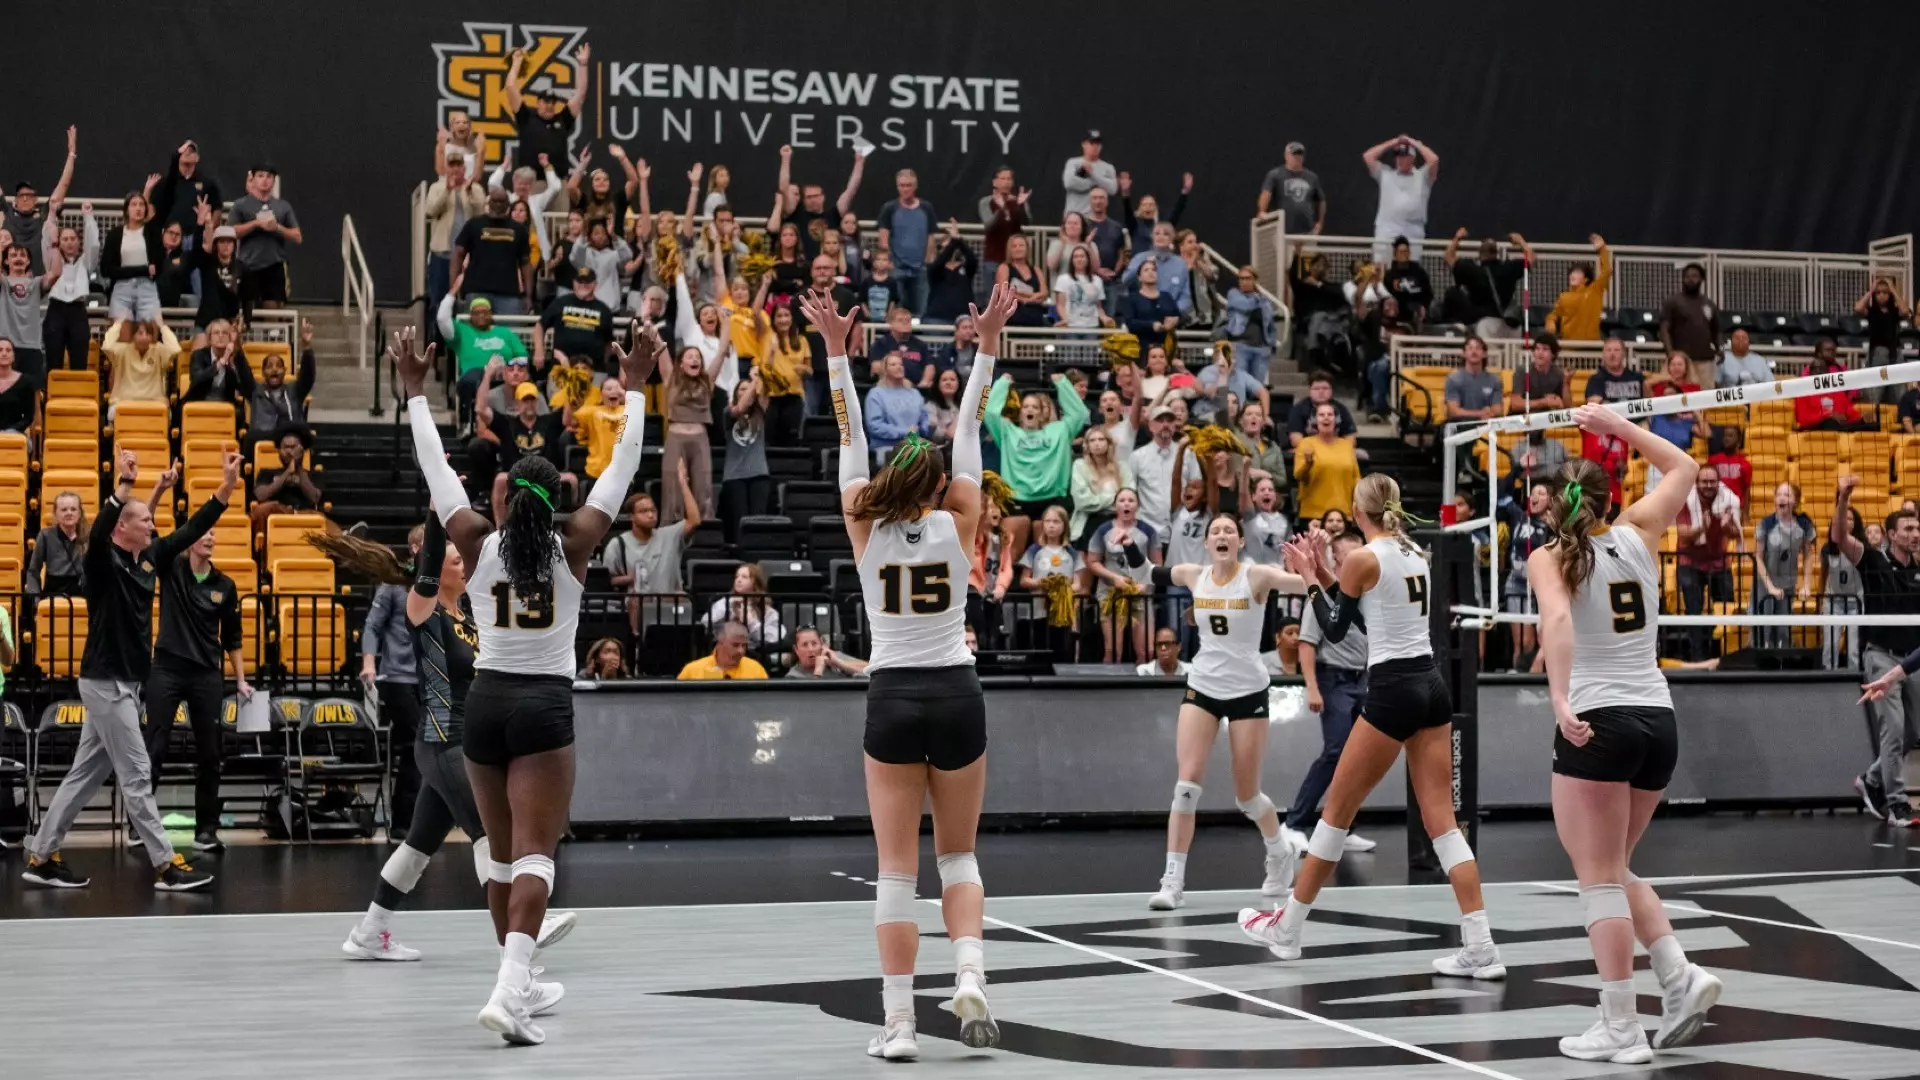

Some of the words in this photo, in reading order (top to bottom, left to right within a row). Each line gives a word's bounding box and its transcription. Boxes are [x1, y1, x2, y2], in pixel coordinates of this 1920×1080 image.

[609, 62, 878, 106] KENNESAW
[889, 74, 1020, 112] STATE
[609, 105, 1020, 155] UNIVERSITY
[1716, 388, 1744, 402] OWLS
[1813, 373, 1845, 390] OWLS
[831, 388, 851, 447] HOOTY
[1548, 410, 1572, 424] OWLS
[1628, 400, 1653, 414] OWLS
[490, 579, 555, 628] 13
[878, 560, 951, 615] 15
[1403, 573, 1428, 617] 4
[1608, 580, 1646, 634] 9
[1209, 614, 1230, 636] 8
[314, 704, 356, 724] OWLS
[1451, 729, 1462, 766] sports
[1451, 767, 1462, 812] imports
